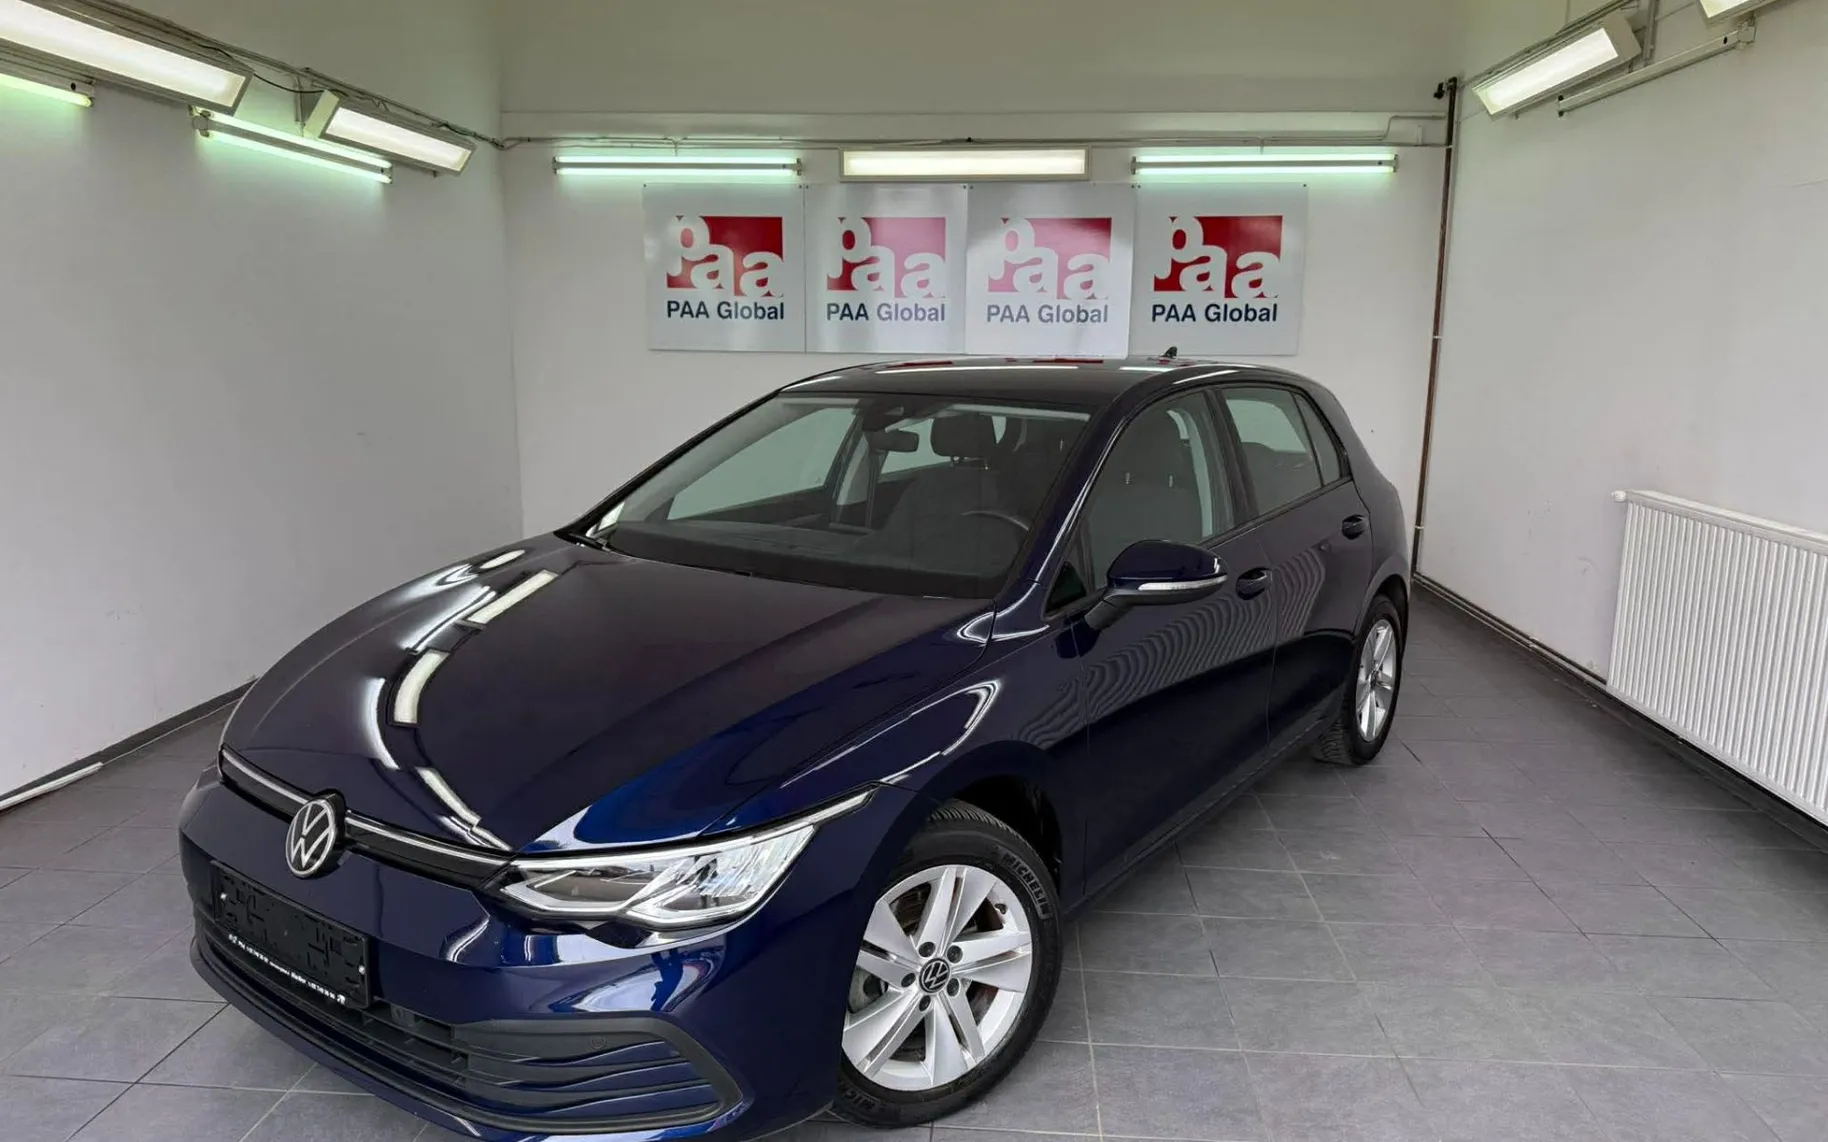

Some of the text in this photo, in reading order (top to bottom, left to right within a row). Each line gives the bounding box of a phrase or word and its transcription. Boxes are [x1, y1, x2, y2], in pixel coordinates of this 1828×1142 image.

[667, 301, 784, 320] PAA Global
[827, 303, 945, 322] PAA Global
[986, 304, 1108, 323] PAA Global
[1152, 303, 1277, 323] PAA Global
